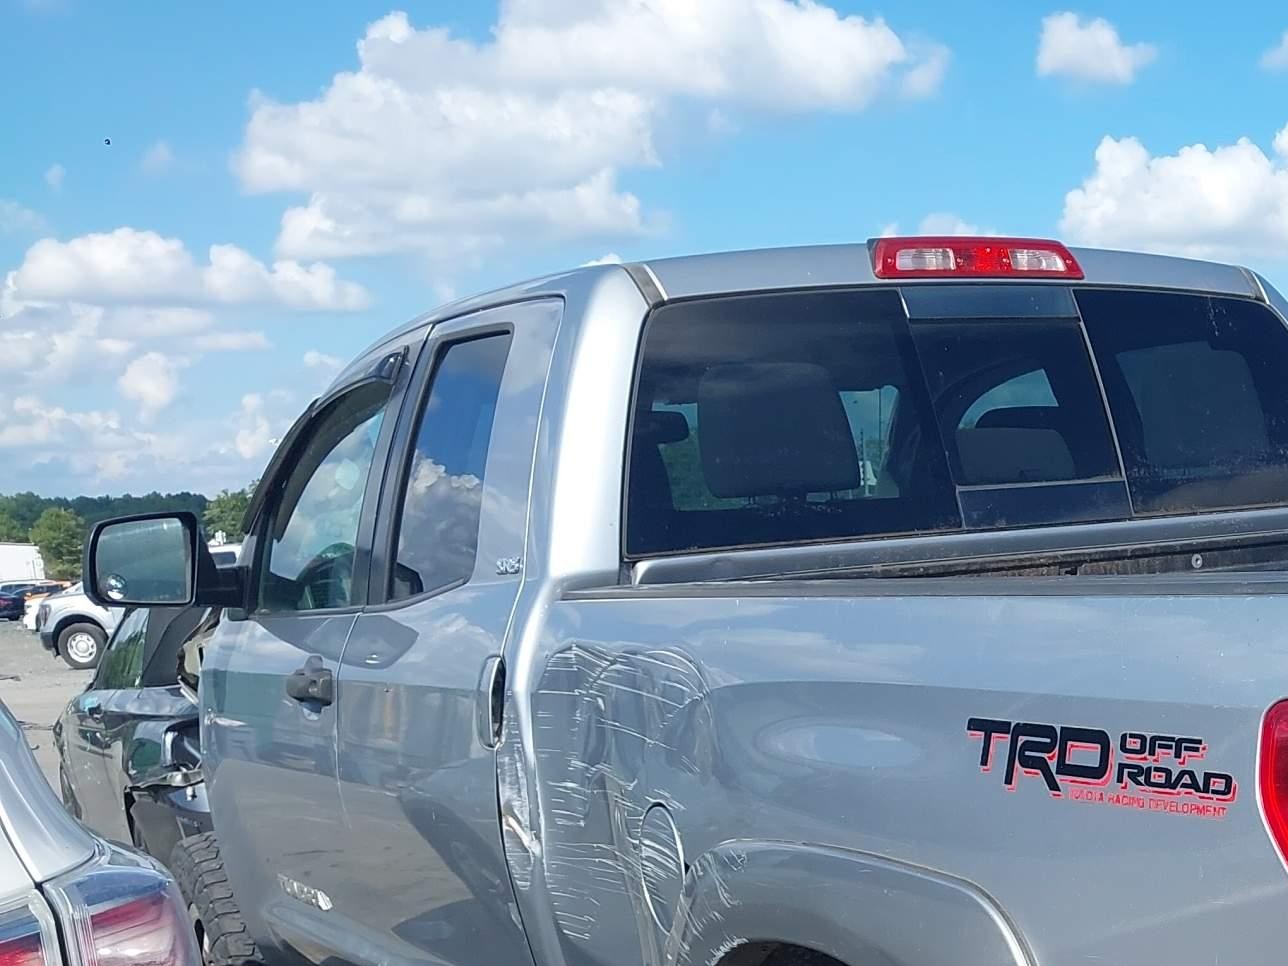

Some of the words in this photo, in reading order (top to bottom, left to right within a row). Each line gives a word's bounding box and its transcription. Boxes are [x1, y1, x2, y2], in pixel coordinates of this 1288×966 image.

[966, 717, 1114, 797] TRD
[1119, 732, 1208, 765] OFF
[1116, 763, 1237, 802] ROAD
[1107, 794, 1145, 810] RACING
[1149, 799, 1227, 818] DEVELOPMENT
